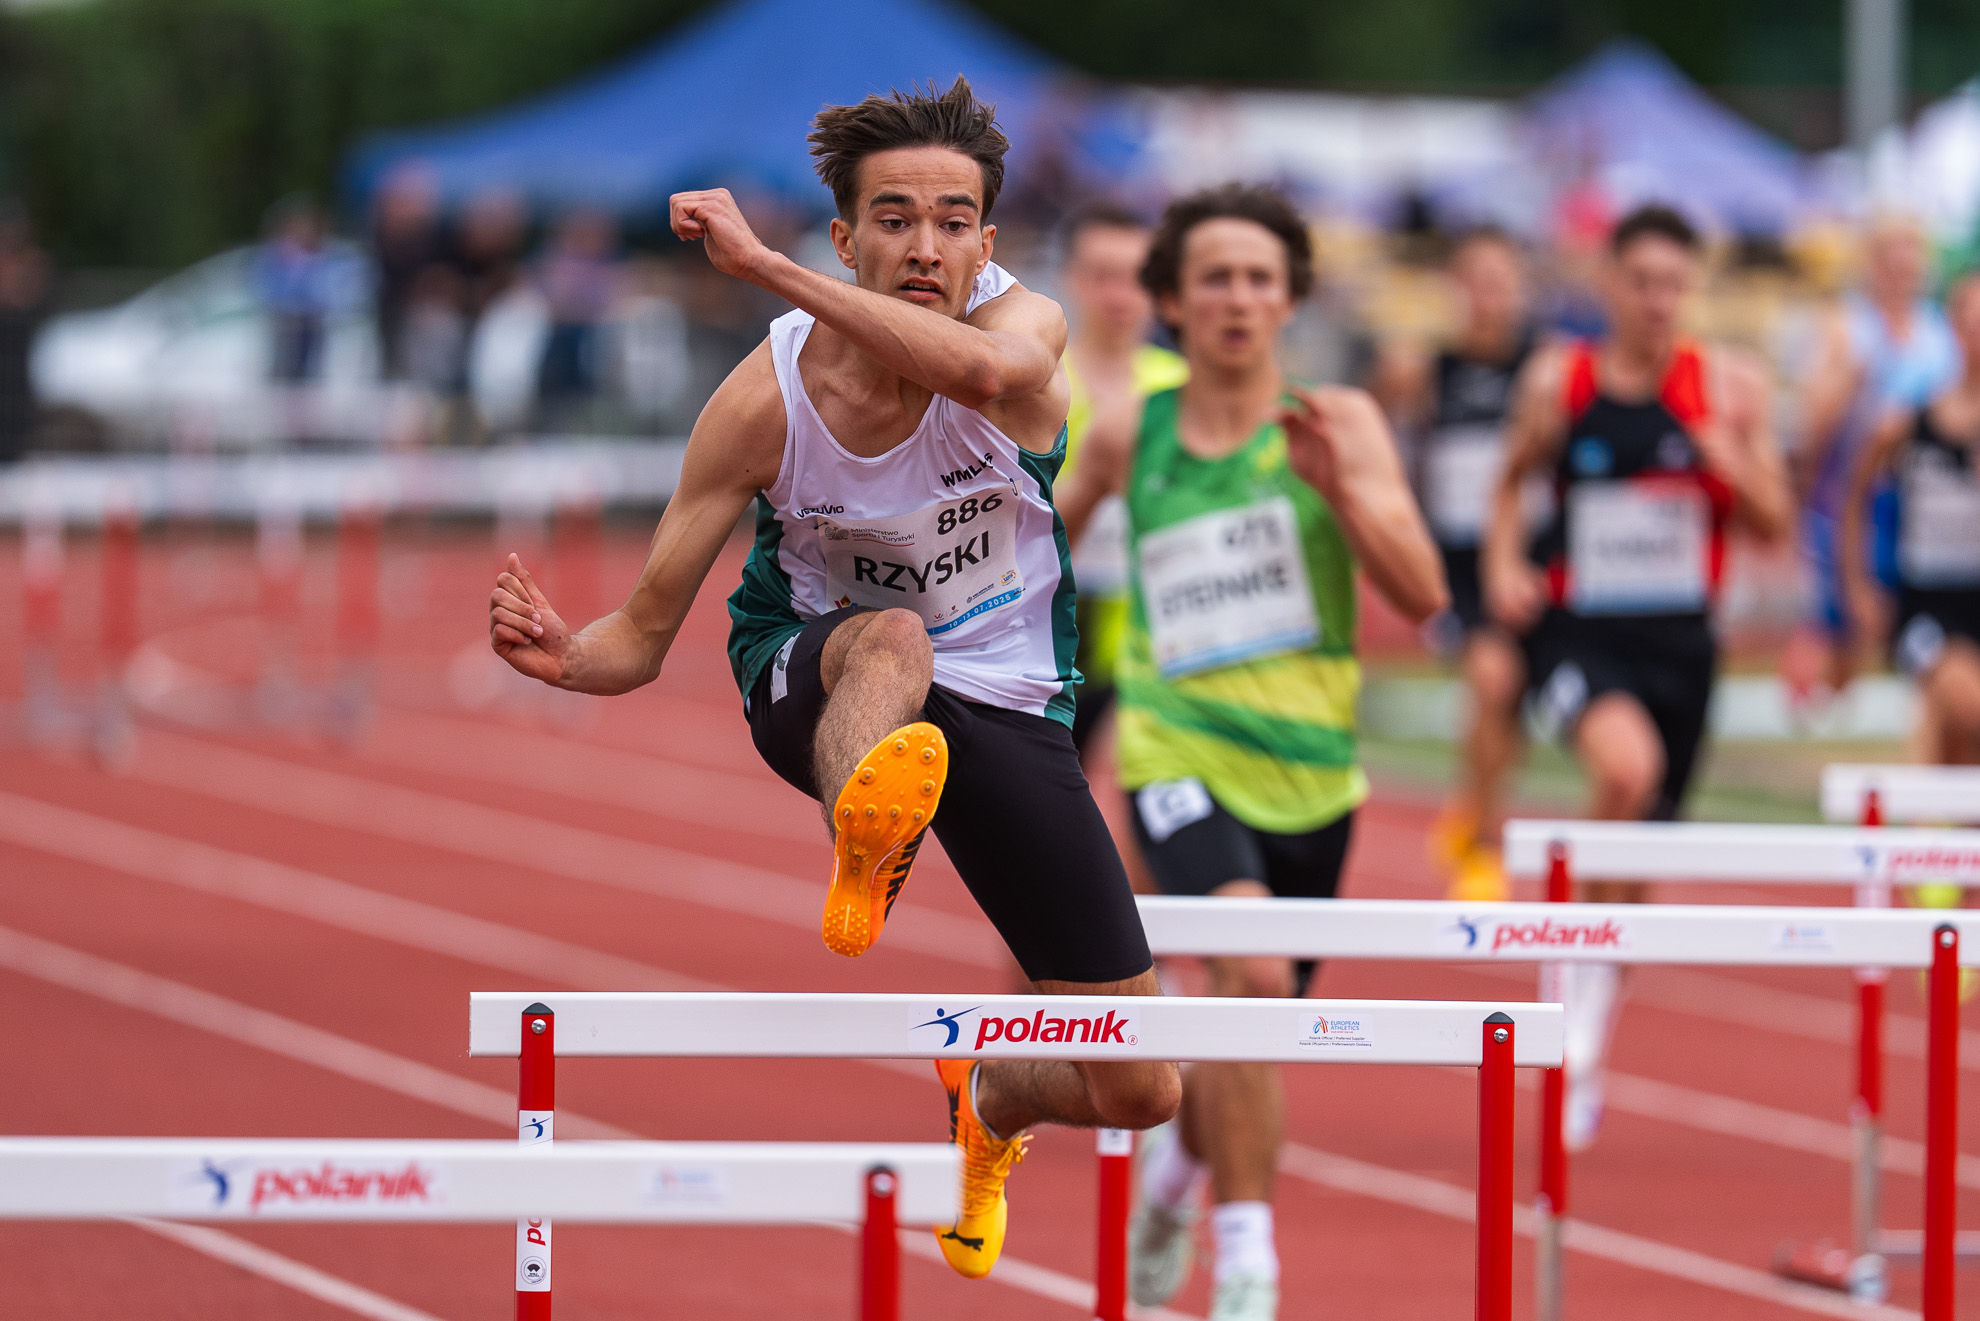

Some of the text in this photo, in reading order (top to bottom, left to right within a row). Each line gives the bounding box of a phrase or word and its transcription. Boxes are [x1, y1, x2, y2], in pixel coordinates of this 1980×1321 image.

[850, 528, 899, 536] Ministerstwo
[937, 492, 1003, 536] 886
[882, 533, 915, 542] Turystyki
[853, 530, 990, 594] RZYSKI
[949, 594, 1011, 629] 10-13.07.2025
[1491, 919, 1621, 953] polanik
[975, 1010, 1129, 1050] polanik
[251, 1163, 430, 1209] polanik
